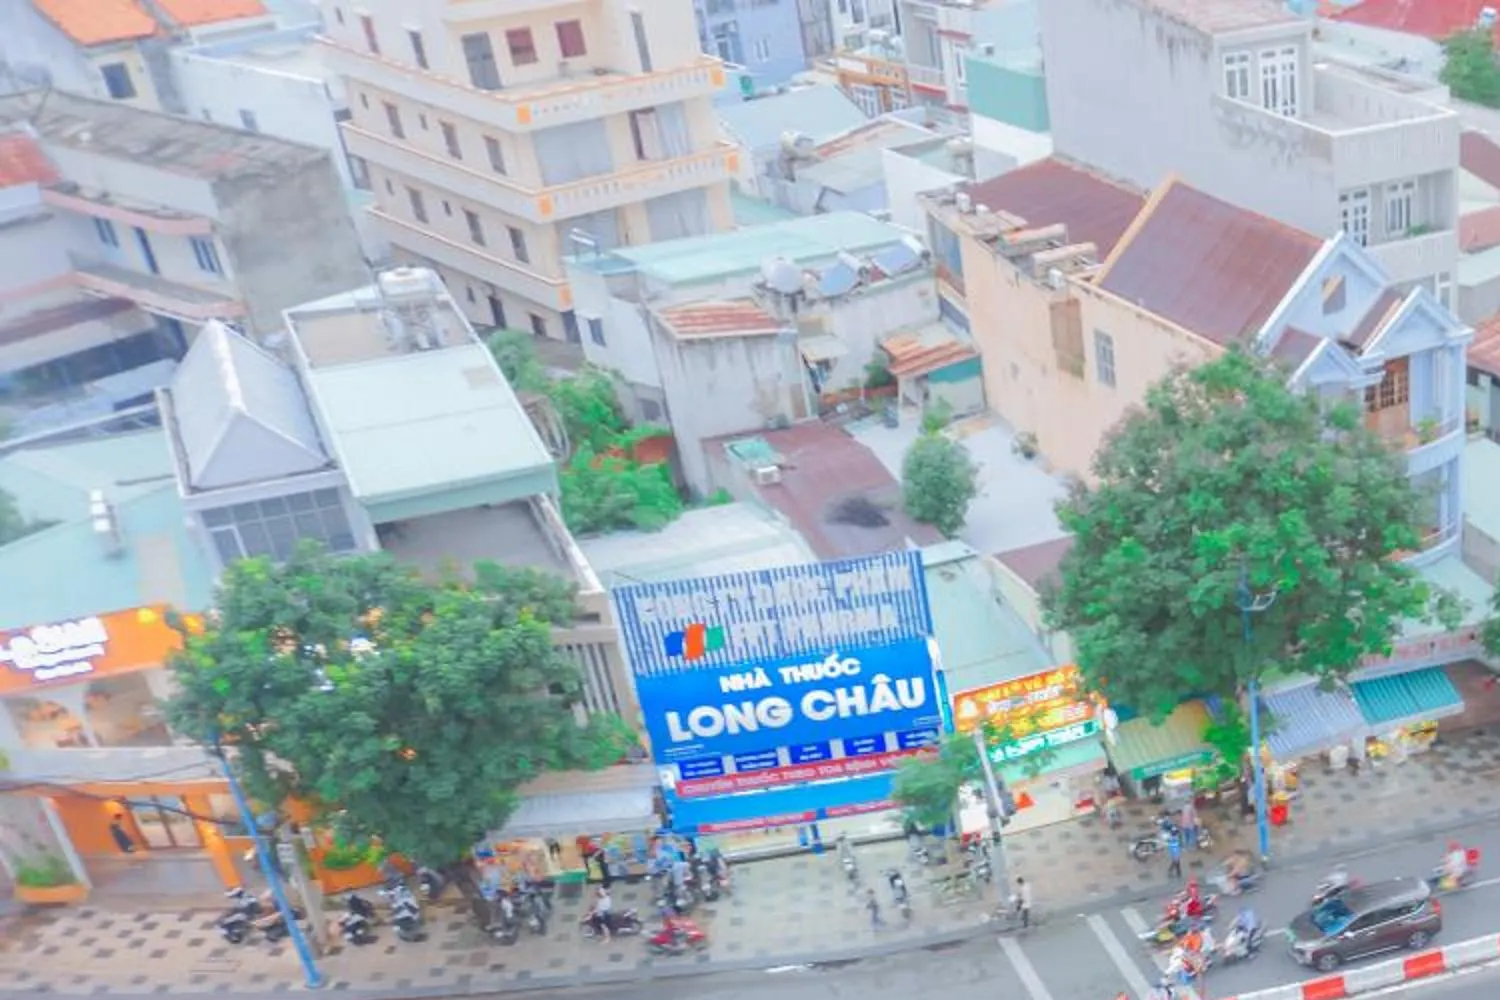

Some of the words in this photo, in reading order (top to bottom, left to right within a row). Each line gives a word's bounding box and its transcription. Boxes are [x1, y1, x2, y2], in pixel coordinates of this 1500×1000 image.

[720, 667, 772, 693] NHÀ
[778, 653, 861, 684] THUỐC
[665, 697, 793, 742] LONG
[801, 673, 925, 721] CHÂU
